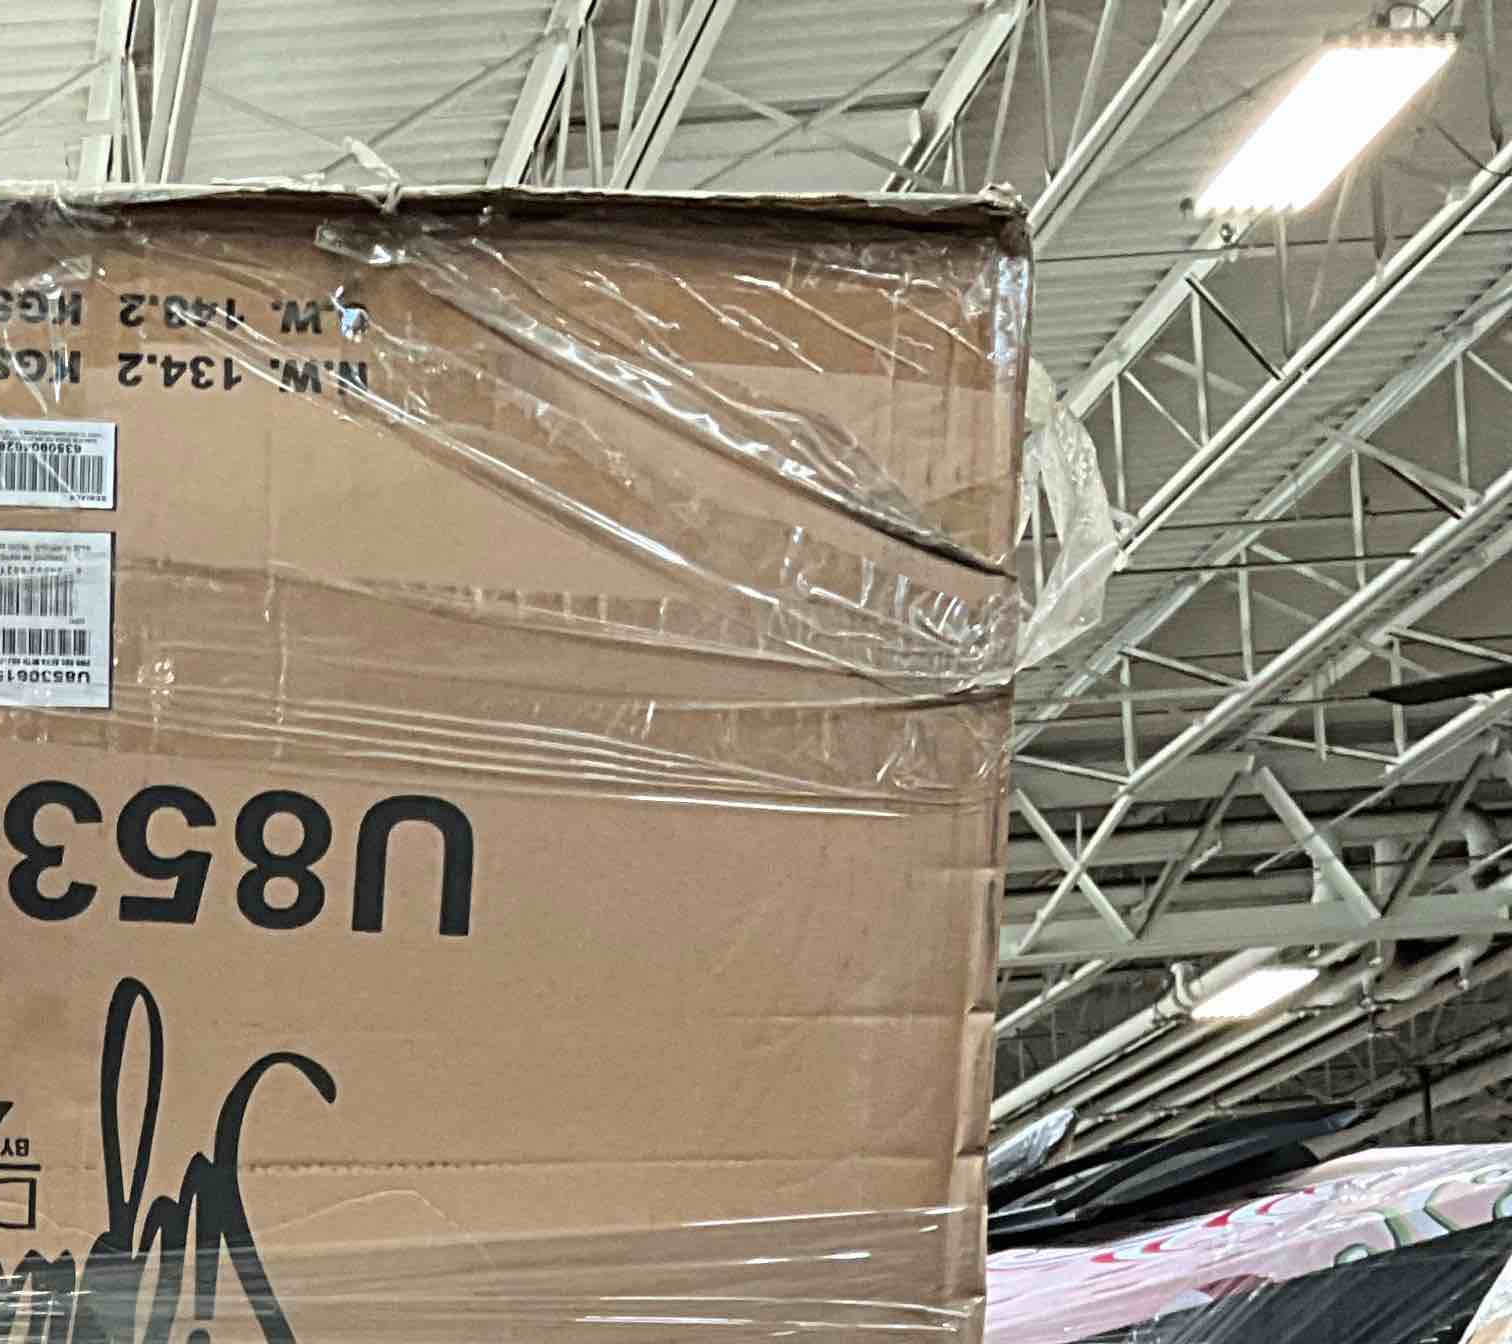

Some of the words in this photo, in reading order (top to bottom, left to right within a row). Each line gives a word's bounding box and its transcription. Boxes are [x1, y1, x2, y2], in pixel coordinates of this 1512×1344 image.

[273, 299, 368, 339] .W.
[117, 352, 242, 390] 134.2
[0, 1138, 30, 1157] BY
